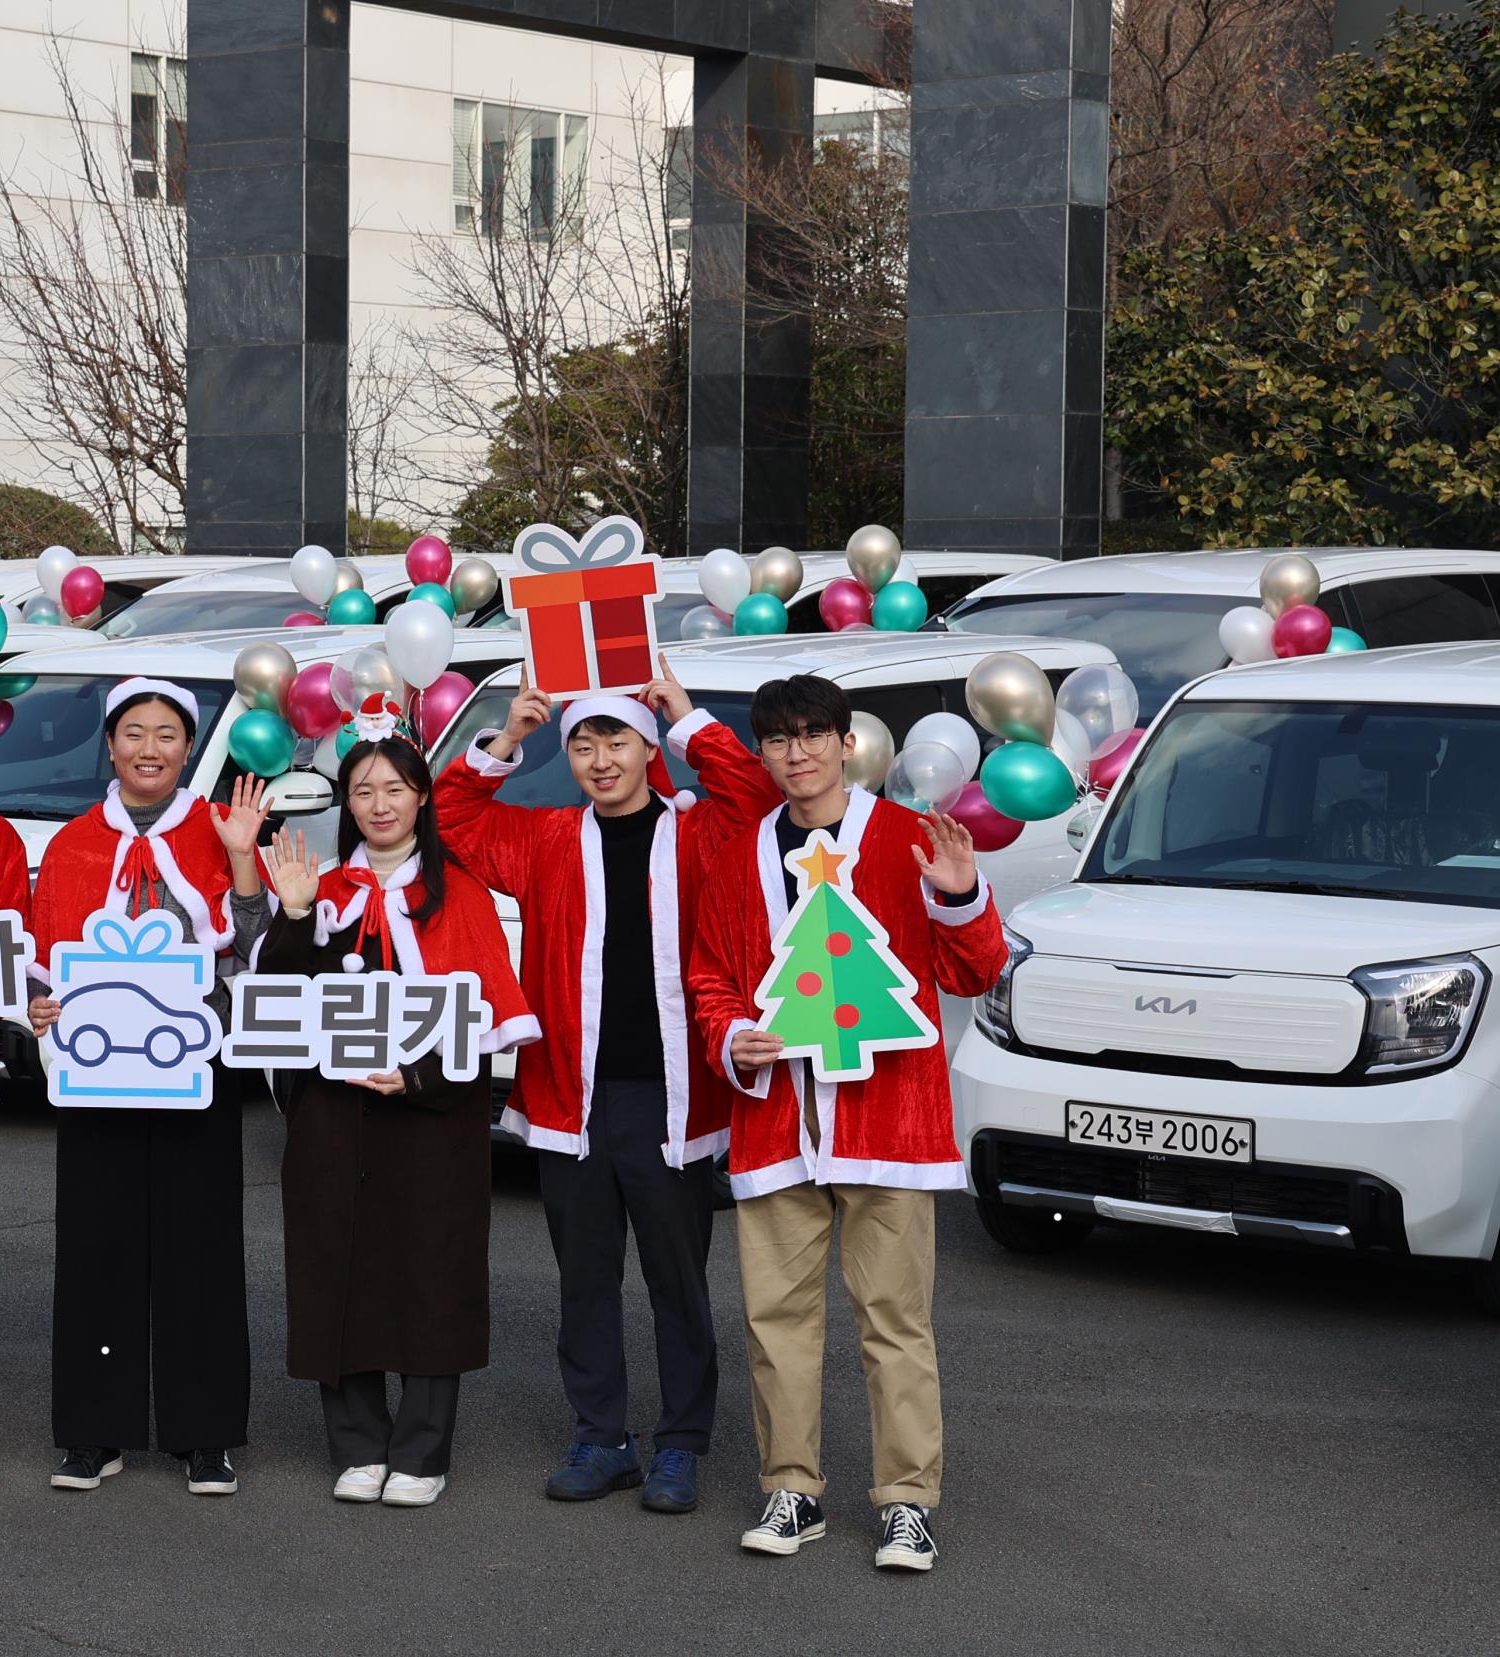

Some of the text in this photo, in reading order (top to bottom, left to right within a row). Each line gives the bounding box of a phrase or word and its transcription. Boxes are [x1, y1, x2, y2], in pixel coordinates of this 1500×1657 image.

[232, 981, 482, 1071] 드림카
[1134, 995, 1197, 1016] KIA
[1079, 1110, 1240, 1157] 243부 2006
